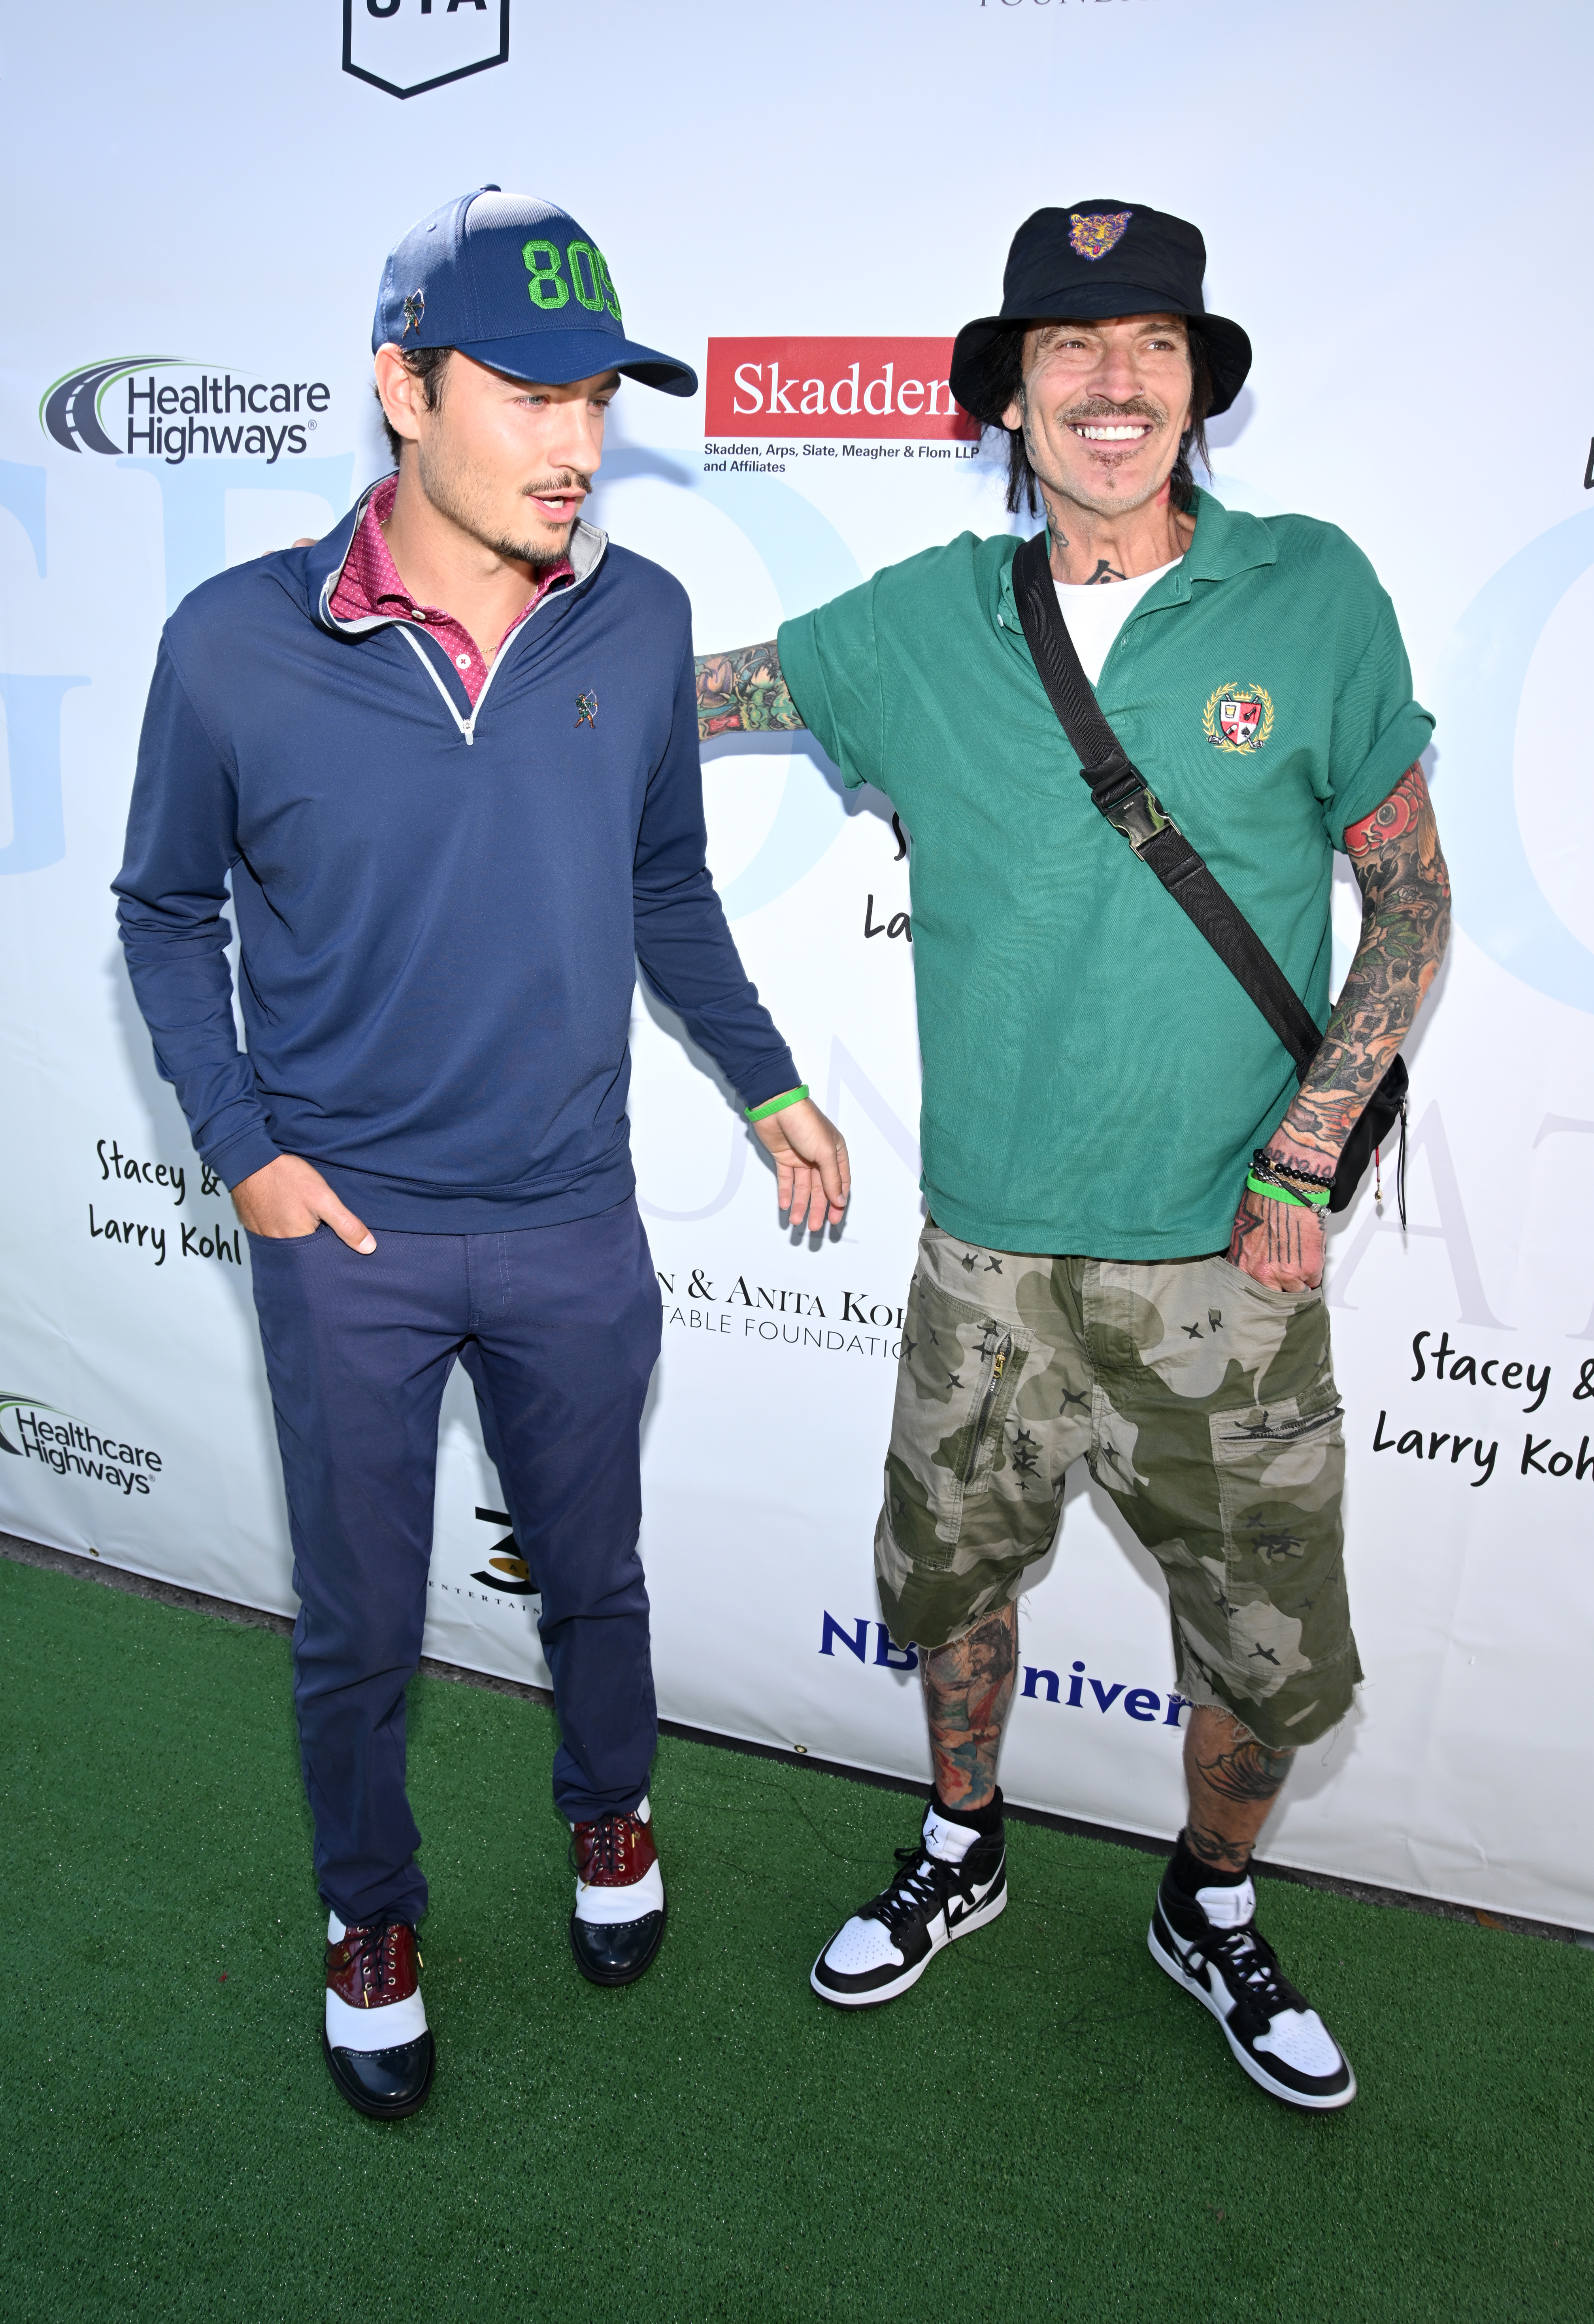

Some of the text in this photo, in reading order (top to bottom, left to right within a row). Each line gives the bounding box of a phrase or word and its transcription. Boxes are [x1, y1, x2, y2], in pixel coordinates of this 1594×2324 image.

[128, 375, 330, 415] Healthcare
[733, 362, 960, 415] Skadden
[703, 460, 786, 472] and Affiliates
[704, 443, 980, 460] Skadden, Arps, Slate, Meagher & Flom LLP
[97, 1139, 221, 1206] Stacey &
[89, 1203, 242, 1266] Larry Kohl
[688, 1269, 717, 1301] &
[1411, 1330, 1594, 1413] Stacey &
[15, 1407, 162, 1472] Healthcare
[1373, 1410, 1498, 1487] Larry
